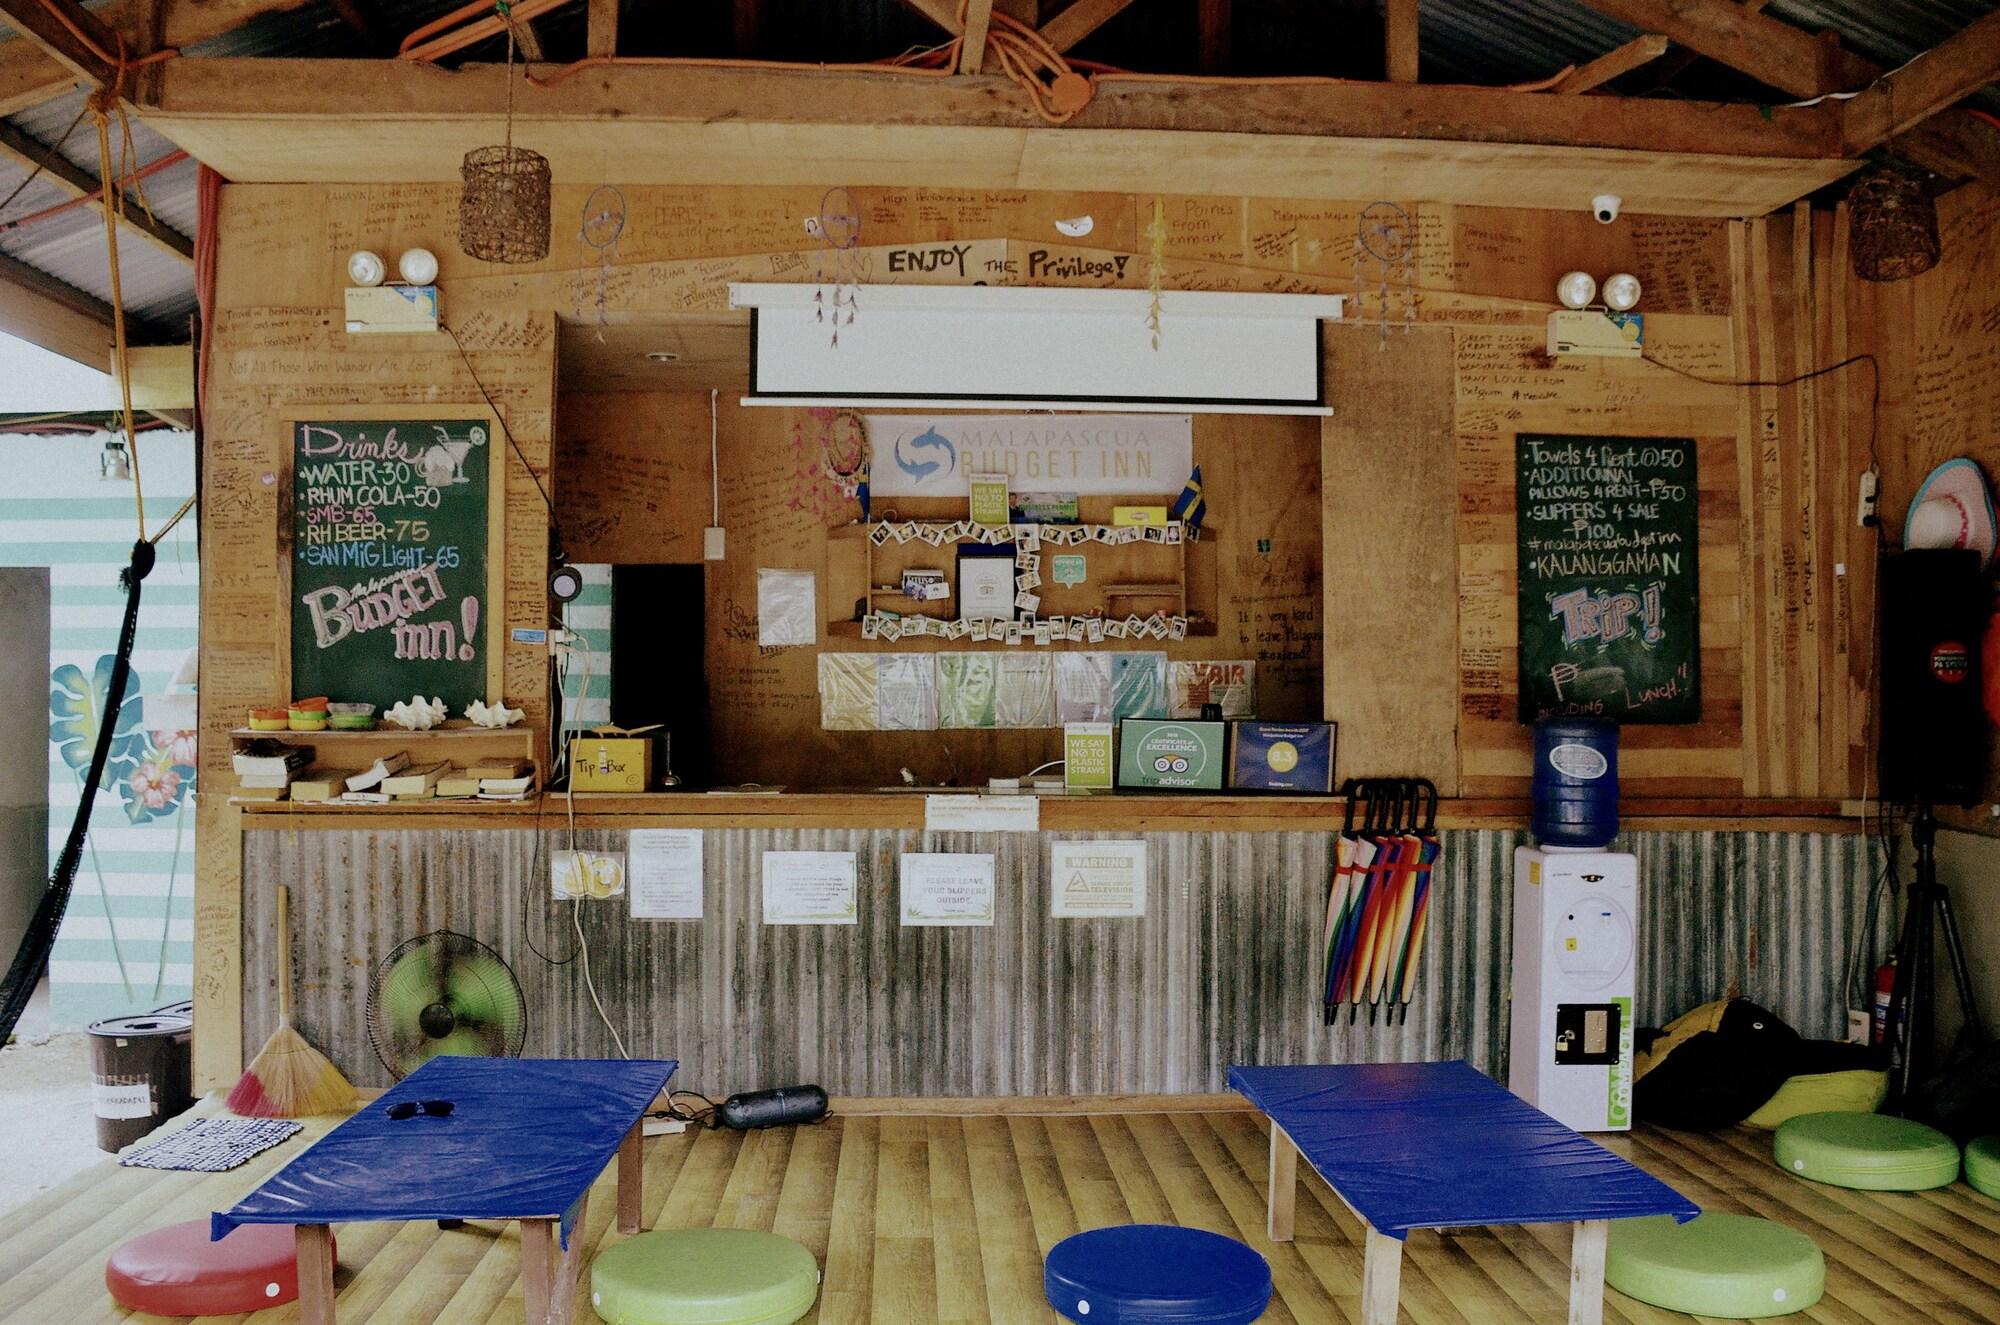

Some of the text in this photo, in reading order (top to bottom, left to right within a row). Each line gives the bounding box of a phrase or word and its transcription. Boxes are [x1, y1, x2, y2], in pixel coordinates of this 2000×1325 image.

[888, 244, 973, 277] ENJOY
[983, 259, 1019, 274] THE
[1494, 375, 1527, 384] LOVE
[300, 424, 424, 463] Drinks
[958, 429, 1152, 448] MALAPASCUA
[1527, 441, 1581, 465] Towels
[1584, 445, 1598, 467] 4
[959, 450, 1153, 479] BUDGET INN
[307, 486, 353, 506] RHUM
[1528, 484, 1590, 501] PILLOWS
[1593, 485, 1604, 500] 4
[1532, 500, 1661, 522] SLIPPERS 4 SALE
[307, 524, 332, 546] RH
[306, 545, 340, 567] SAN
[1210, 664, 1246, 686] BIR
[1070, 739, 1106, 748] WE SAY
[1070, 748, 1106, 757] NO TO
[1146, 743, 1199, 753] EXCELLENCE
[575, 758, 626, 779] Tip Box
[1070, 758, 1106, 767] PLASTIC
[1070, 766, 1106, 775] STRAWS
[1071, 857, 1129, 868] WARNING
